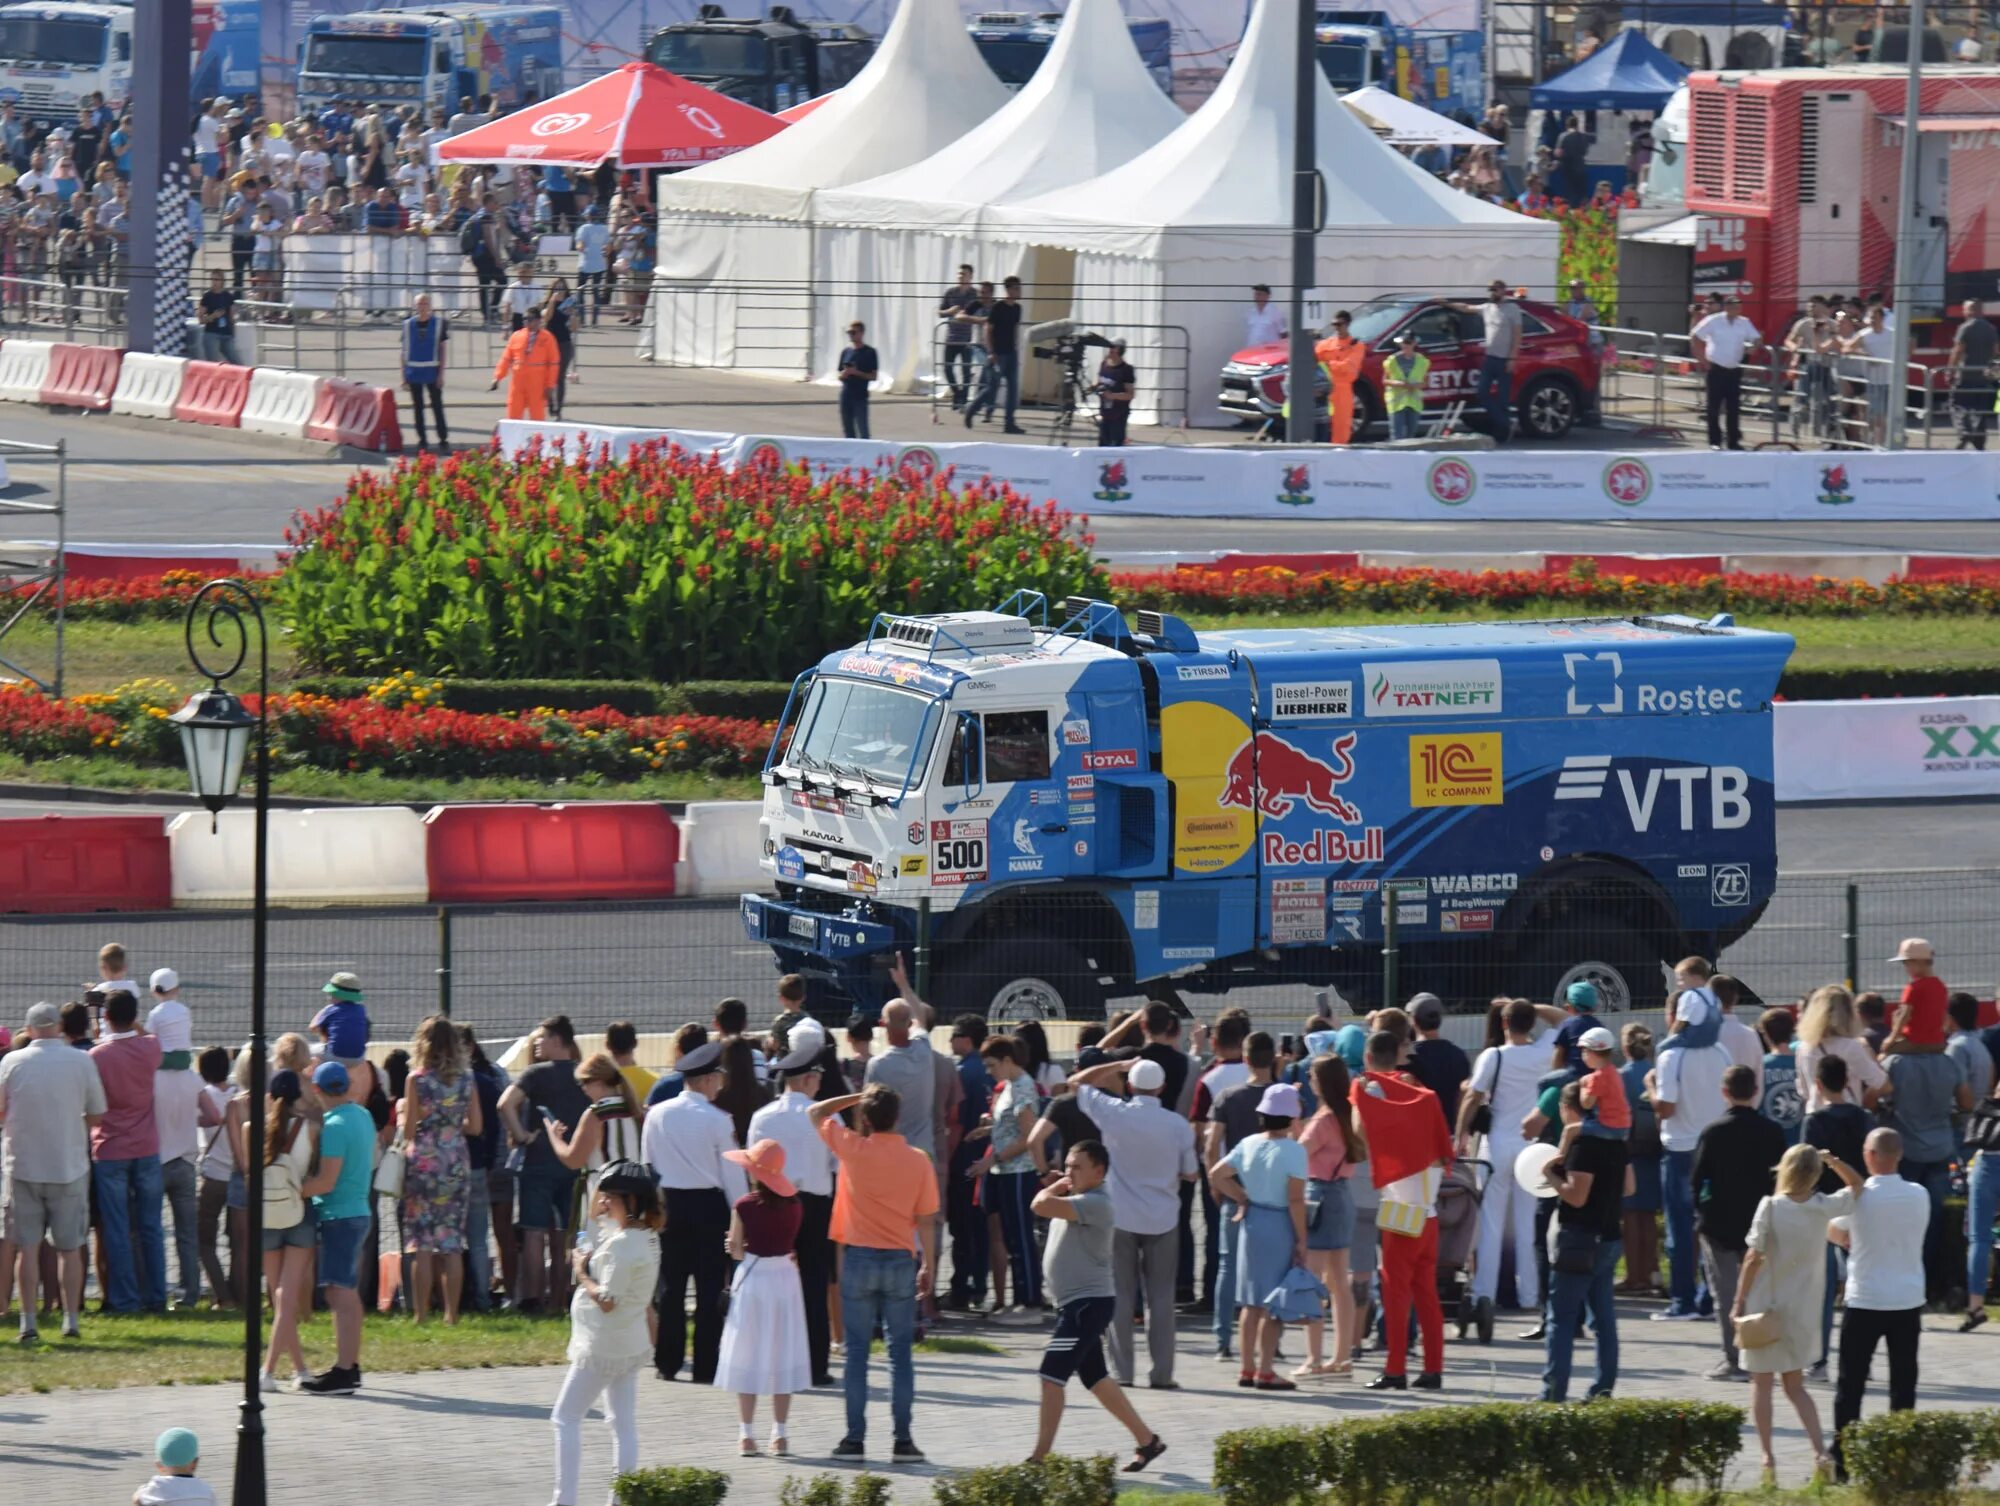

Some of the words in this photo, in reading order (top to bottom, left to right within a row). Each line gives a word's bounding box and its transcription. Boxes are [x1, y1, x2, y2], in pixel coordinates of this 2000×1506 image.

[1275, 687, 1348, 699] Diesel-Power
[1393, 682, 1450, 692] ТОПЛИВНЫЙ
[1453, 681, 1495, 690] ПАРТНЕР
[1393, 690, 1495, 707] TATNEFT
[1638, 684, 1743, 712] Rostec
[1276, 702, 1348, 716] LIEBHERR
[1083, 754, 1135, 767] TOTAL
[1442, 786, 1492, 797] COMPANY
[1617, 766, 1751, 832] VTB
[802, 829, 844, 844] KAMAZ
[1263, 829, 1323, 865] Red
[1326, 826, 1384, 863] Bull
[938, 840, 984, 870] 500
[1008, 860, 1043, 872] KAMAZ
[1679, 866, 1706, 877] LEONI
[935, 875, 962, 883] MOTUL
[1431, 873, 1519, 894] WABCO
[1719, 873, 1745, 896] ZF
[1278, 897, 1319, 907] MOTUL
[831, 932, 851, 948] VTB
